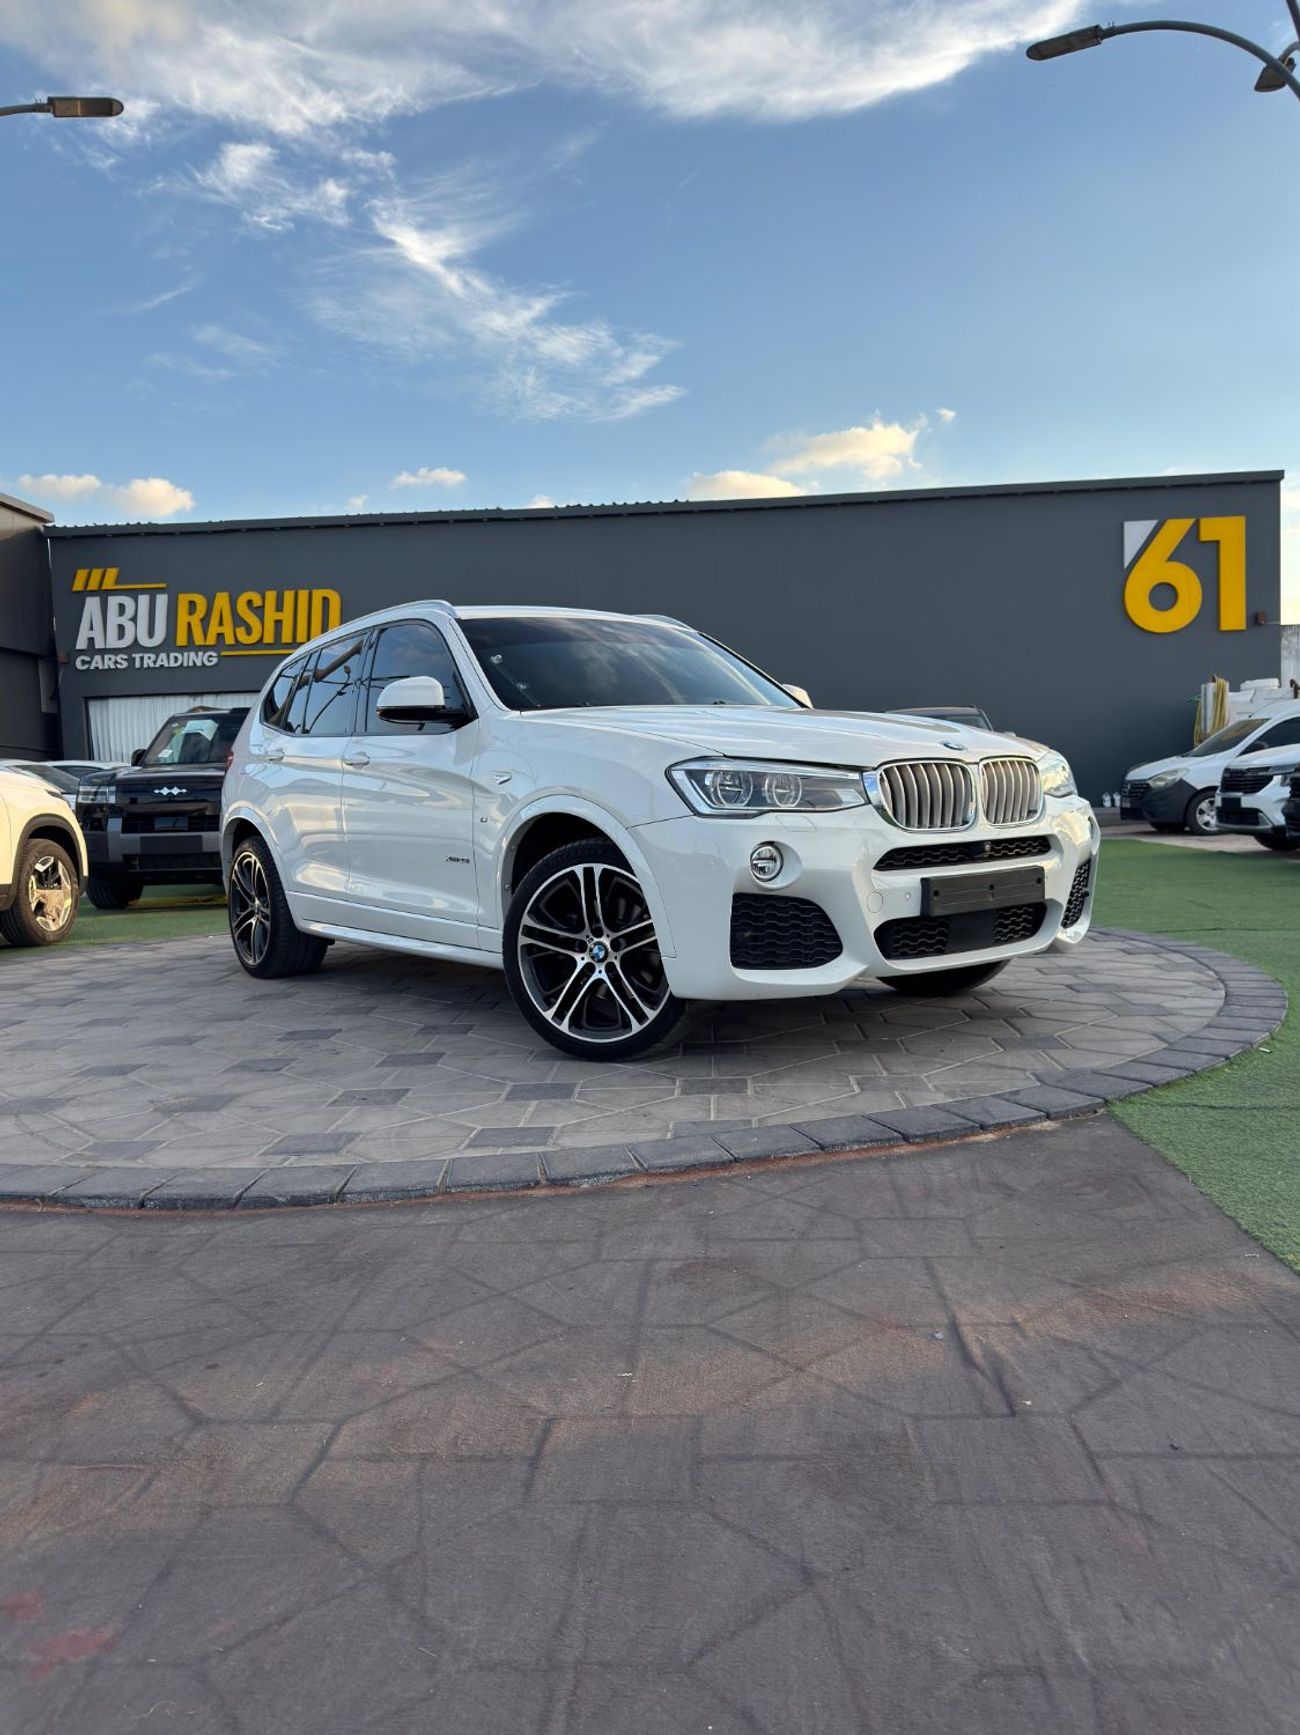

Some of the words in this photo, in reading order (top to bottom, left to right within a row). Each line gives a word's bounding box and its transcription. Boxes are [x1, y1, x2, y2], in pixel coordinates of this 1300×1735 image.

[1123, 515, 1247, 634] 61
[75, 593, 169, 650] ABU
[175, 588, 342, 647] RASHID
[75, 652, 129, 670] CARS
[132, 651, 219, 669] TRADING
